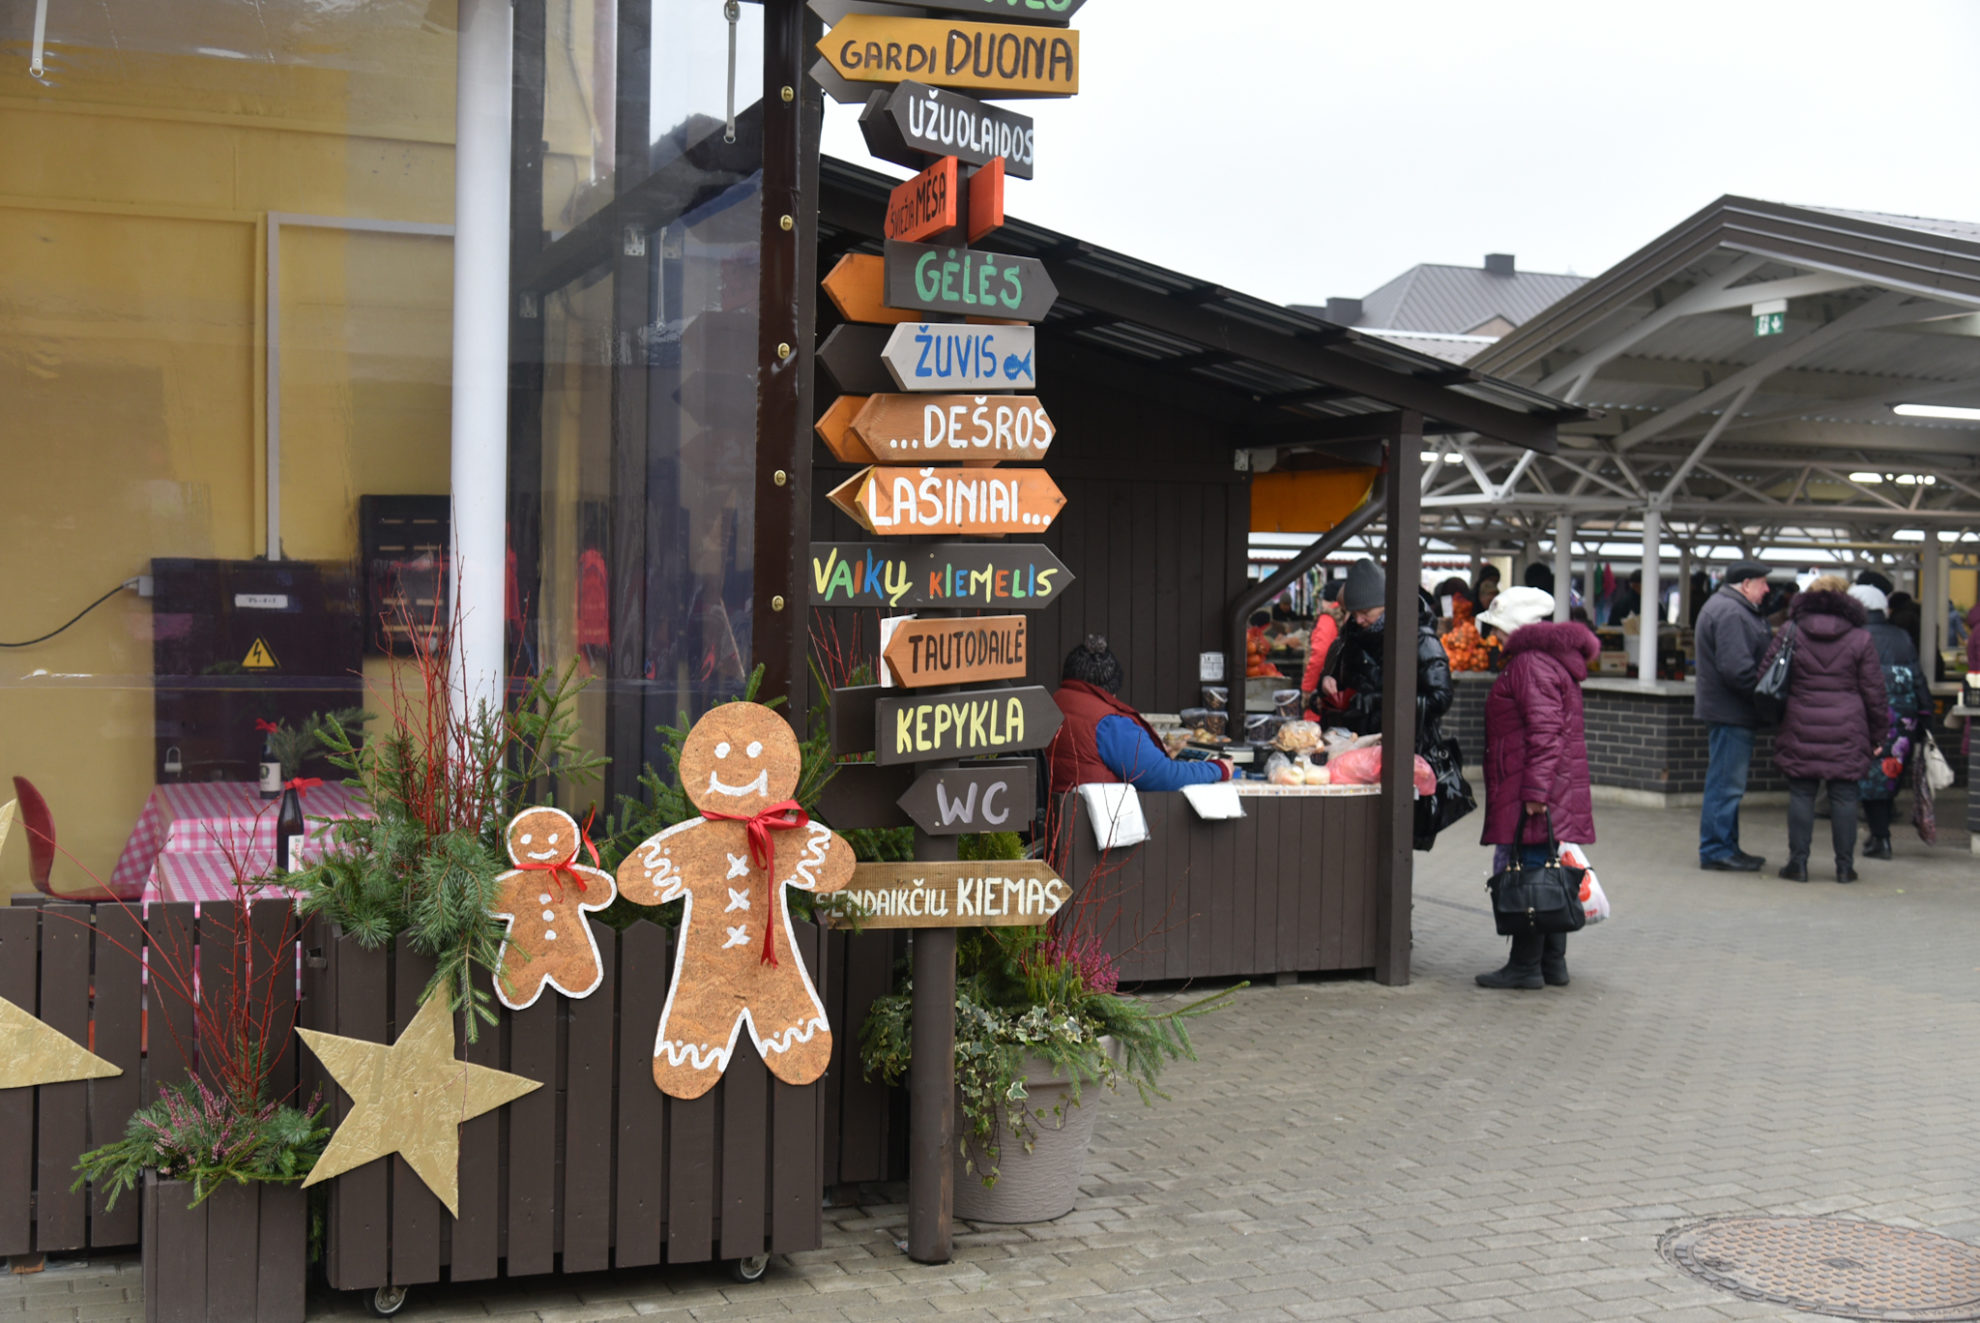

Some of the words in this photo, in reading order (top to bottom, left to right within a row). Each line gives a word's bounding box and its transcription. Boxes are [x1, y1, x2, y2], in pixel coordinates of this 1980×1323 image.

[840, 40, 937, 74] GARDI
[945, 29, 1074, 82] DUONA
[909, 90, 1033, 165] UŽUOLAIDOS
[915, 169, 946, 228] MĖSA
[915, 248, 1023, 309] GĖLĖS
[915, 325, 997, 378] ŽUVIS
[813, 547, 913, 607] VAIKŲ
[929, 563, 1058, 603] KIEMELIS
[908, 622, 1024, 674] TAUTODAILĖ
[897, 697, 1024, 754] KEPYKLA
[936, 781, 1009, 826] WC
[956, 877, 1065, 916] KIEMAS
